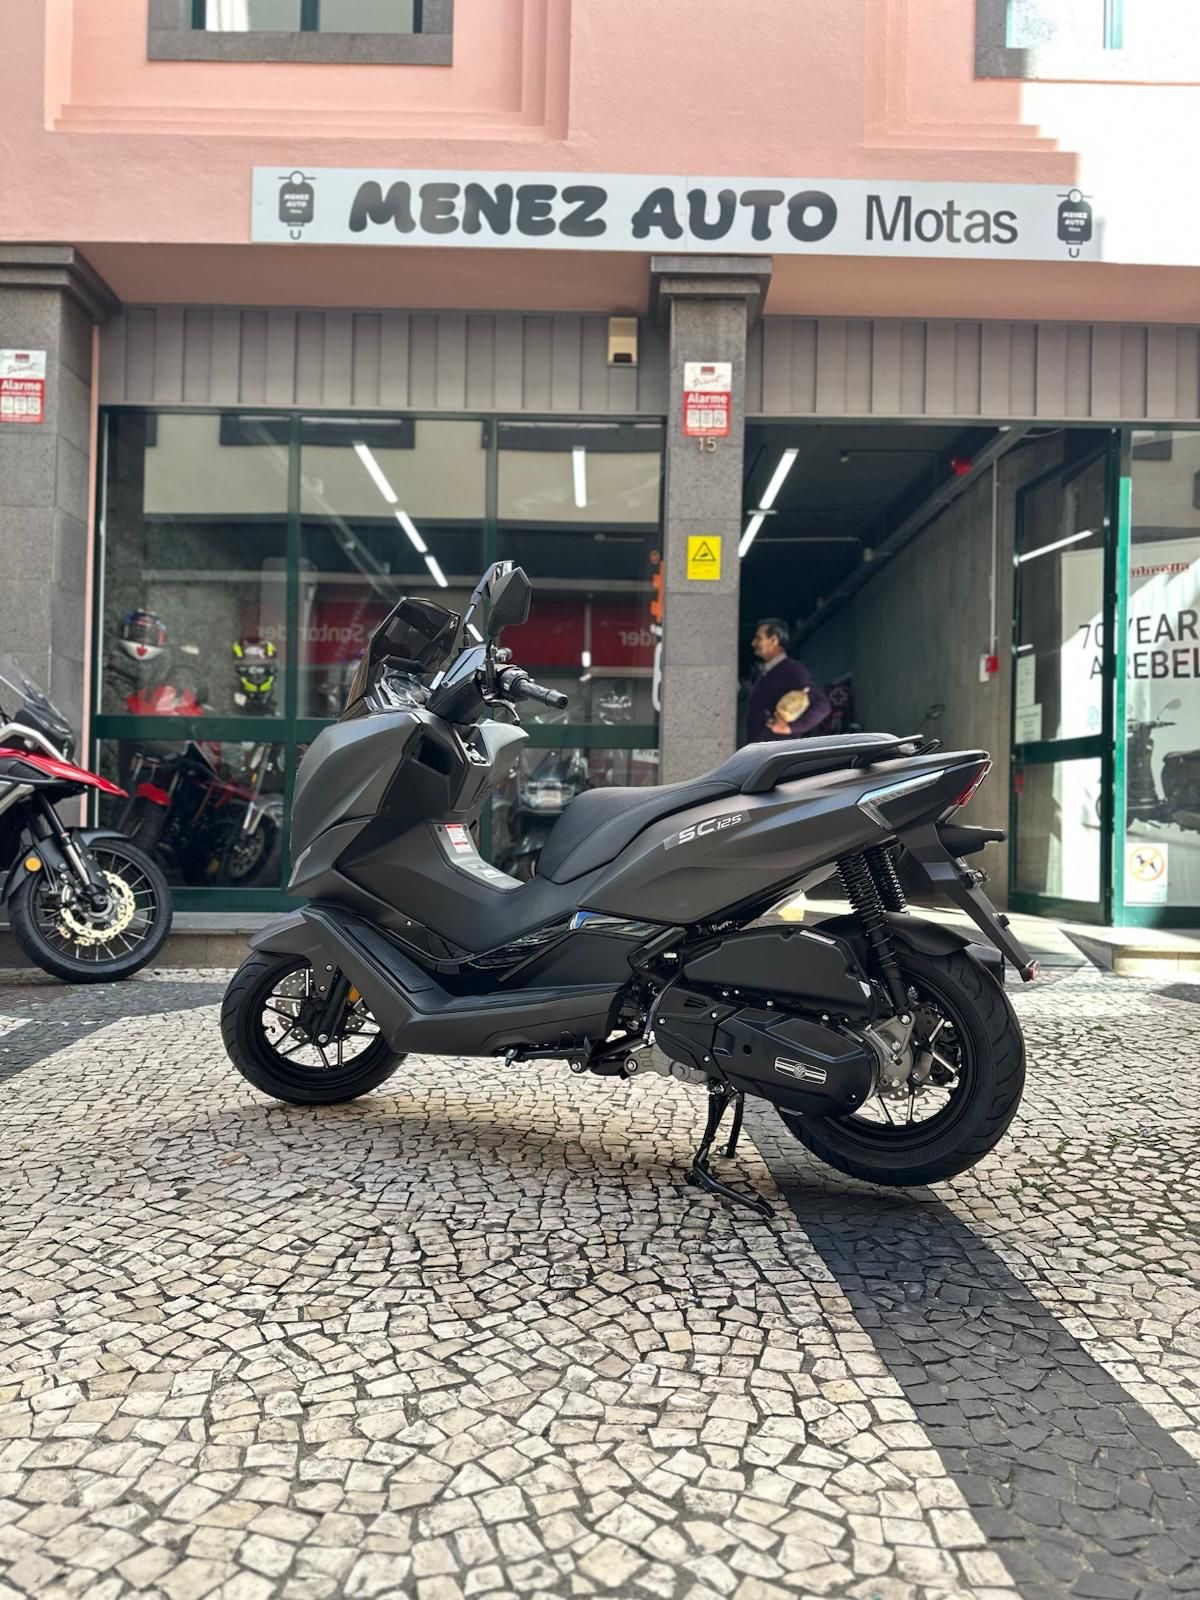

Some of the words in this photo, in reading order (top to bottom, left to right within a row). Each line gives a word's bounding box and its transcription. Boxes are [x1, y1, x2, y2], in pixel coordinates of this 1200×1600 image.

[349, 181, 608, 237] MENEZ
[632, 187, 838, 242] AUTO
[865, 194, 1019, 245] Motas
[1, 379, 42, 391] Alarme
[687, 392, 728, 404] Alarme
[699, 437, 717, 453] 15
[1127, 647, 1200, 680] EBEL
